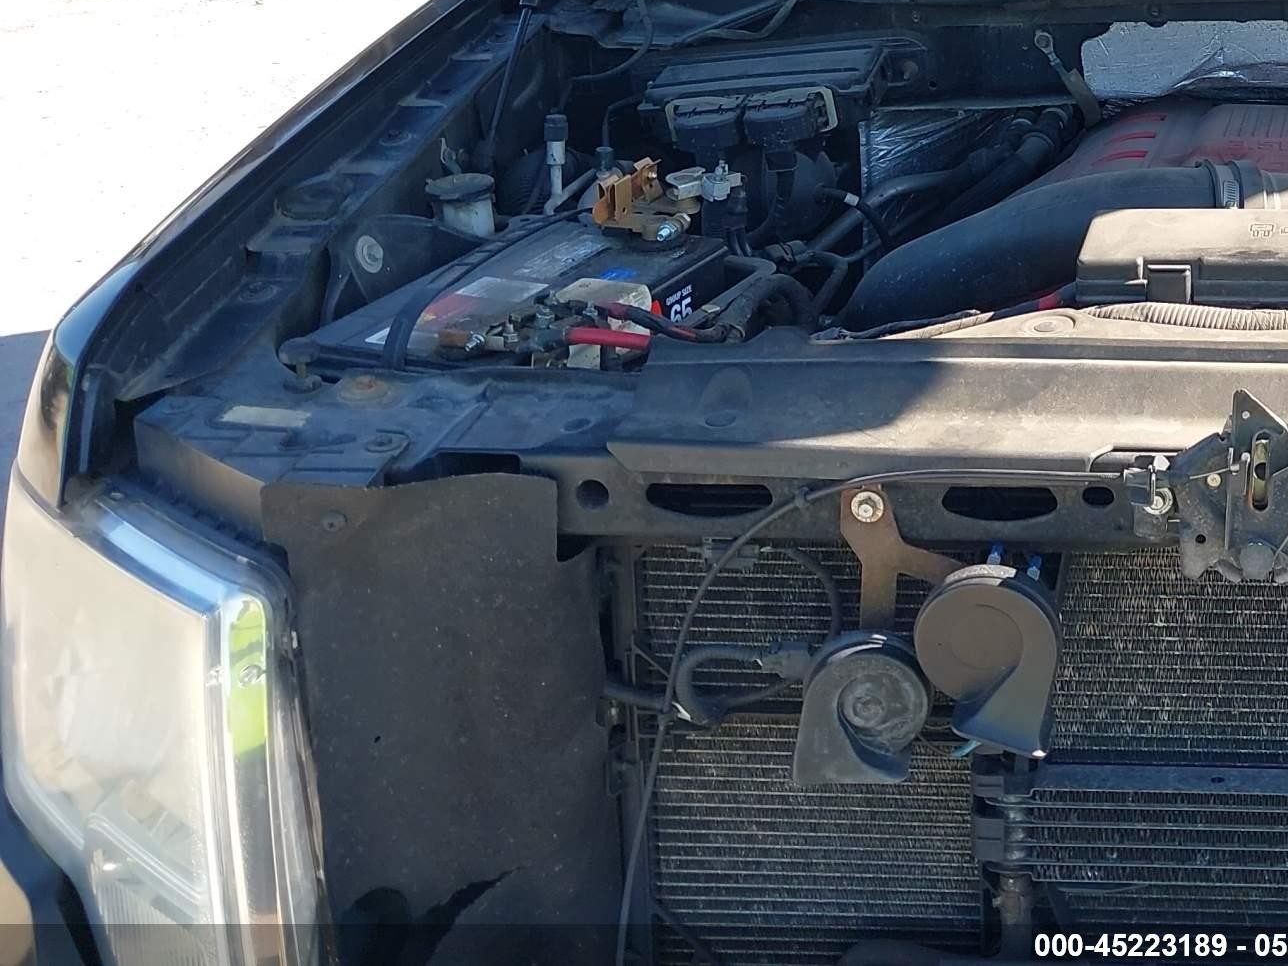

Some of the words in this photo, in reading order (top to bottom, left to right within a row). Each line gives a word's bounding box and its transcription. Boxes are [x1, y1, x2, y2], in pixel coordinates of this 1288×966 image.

[666, 290, 681, 306] GROUP
[681, 284, 692, 297] SIZE
[671, 296, 692, 322] 65
